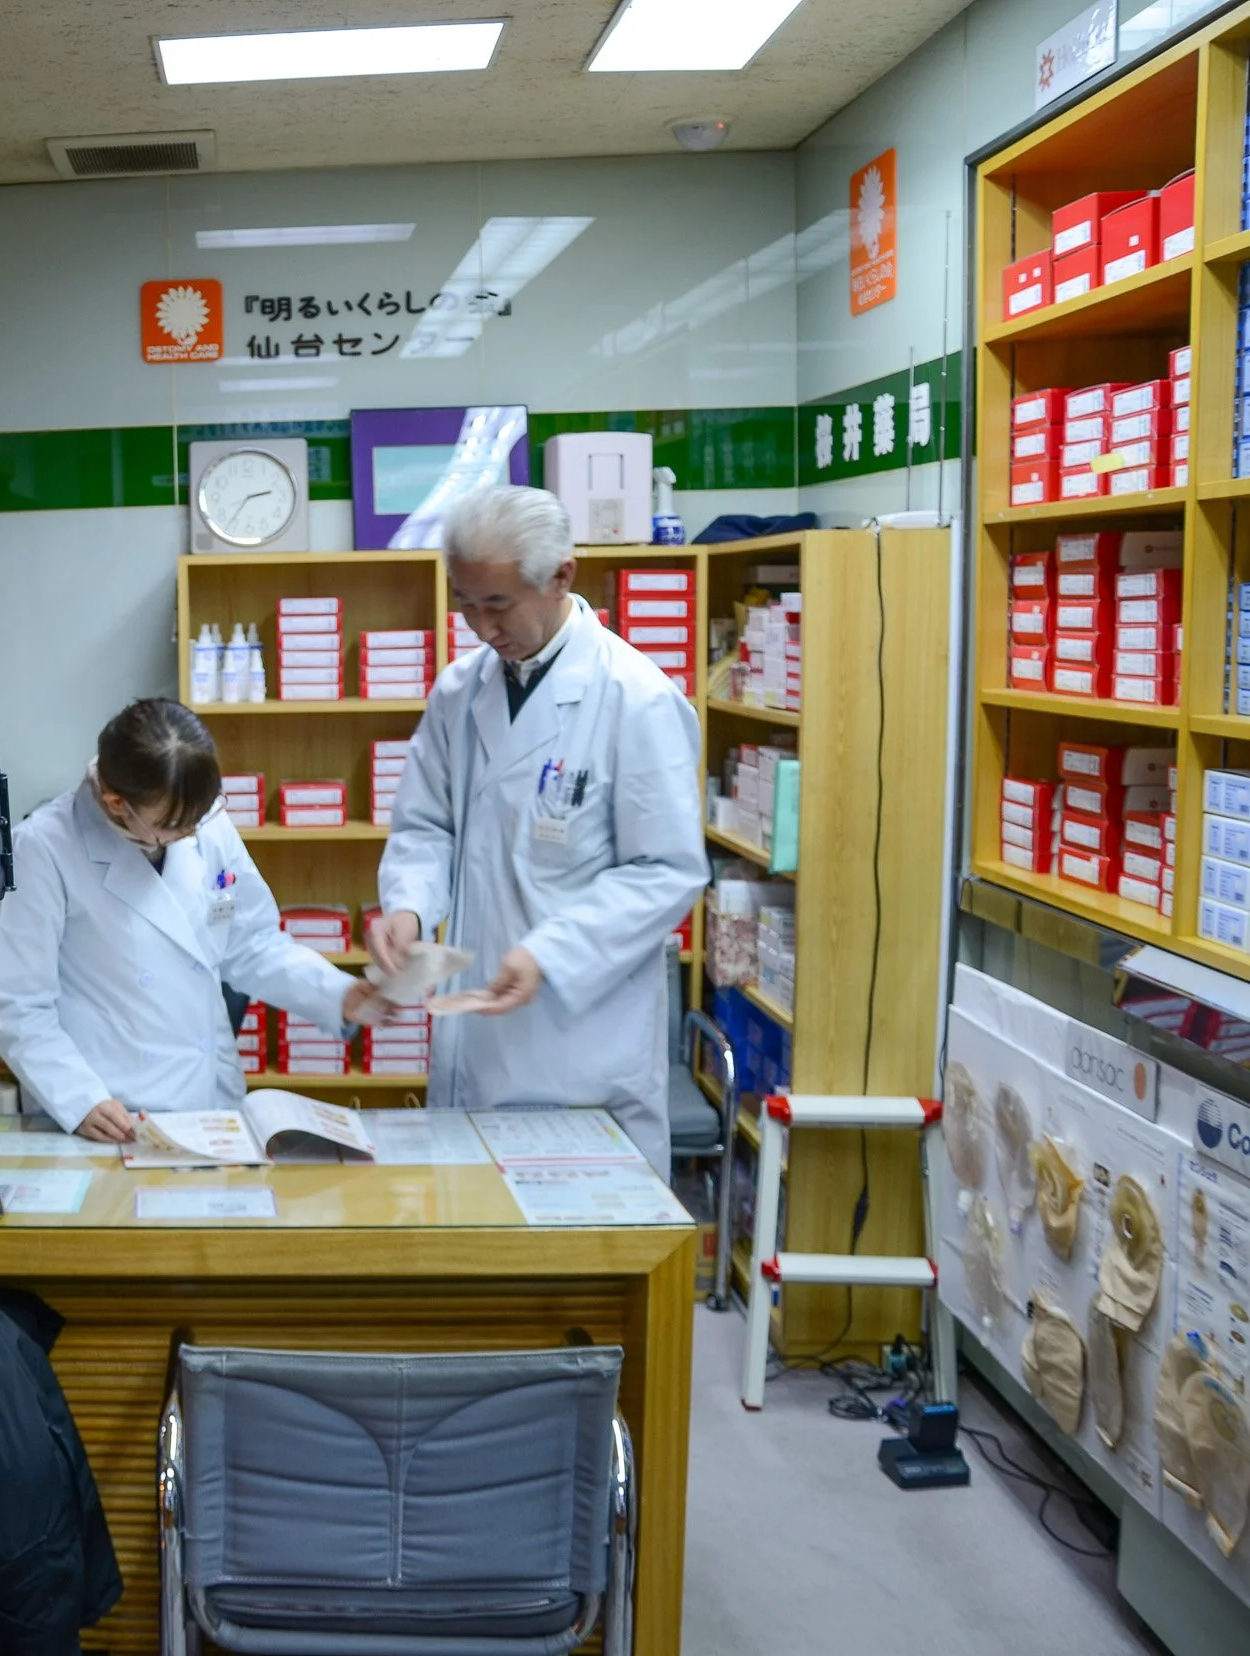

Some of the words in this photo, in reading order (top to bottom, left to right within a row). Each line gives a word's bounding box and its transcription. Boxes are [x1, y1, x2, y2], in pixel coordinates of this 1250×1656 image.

[247, 333, 476, 359] 仙台センター
